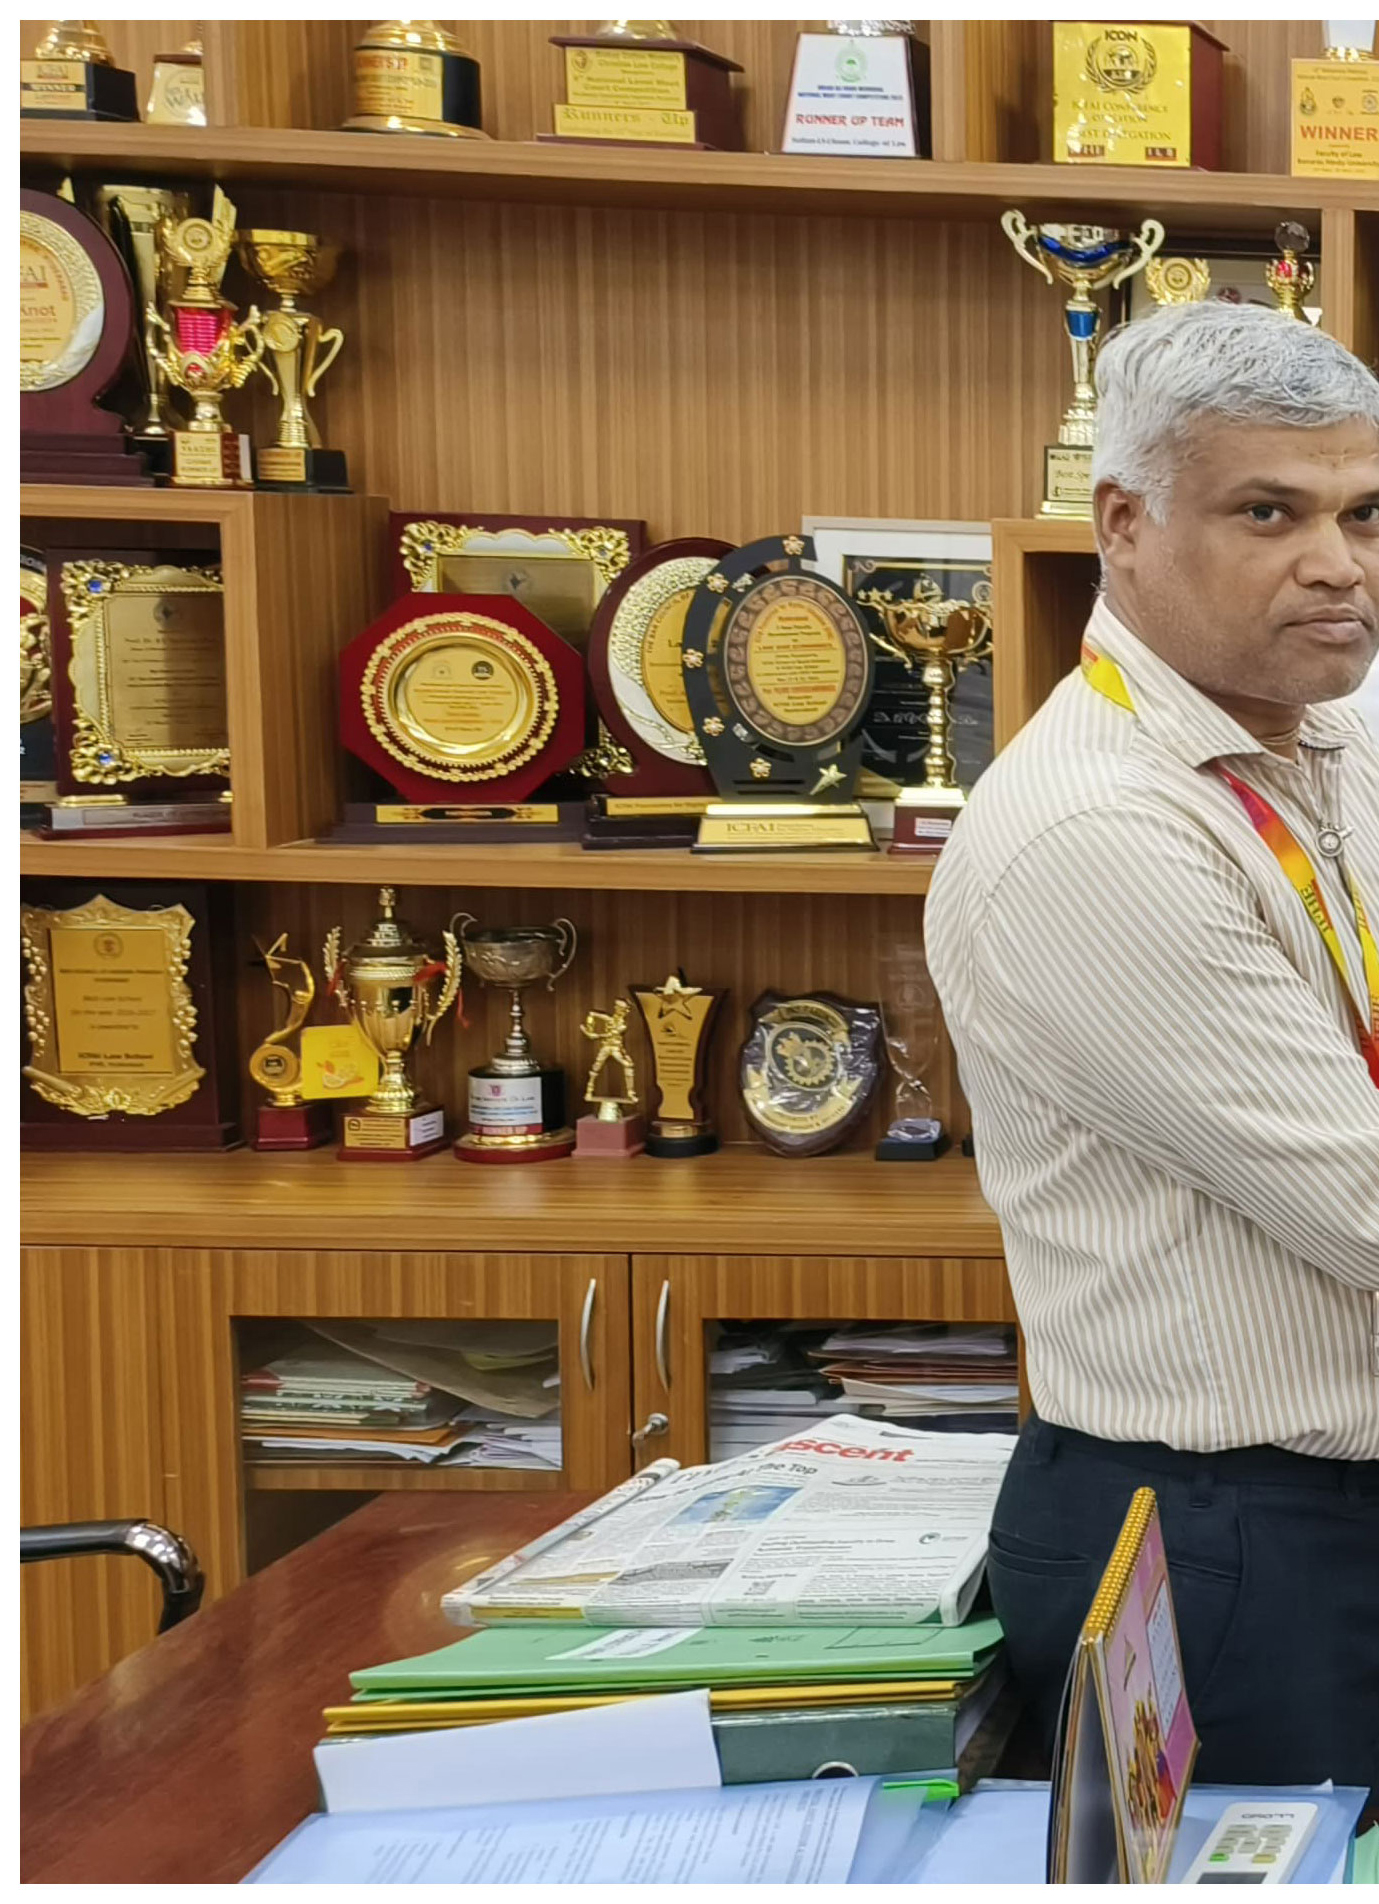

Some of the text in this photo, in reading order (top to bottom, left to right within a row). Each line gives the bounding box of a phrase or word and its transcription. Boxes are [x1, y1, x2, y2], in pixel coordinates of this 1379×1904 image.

[1104, 30, 1138, 41] ICON
[796, 114, 904, 127] RUNNER UP TEAM
[1300, 125, 1379, 141] WINNER
[726, 822, 775, 832] ICFAI
[1300, 885, 1330, 933] IFHE
[789, 1462, 818, 1476] Top
